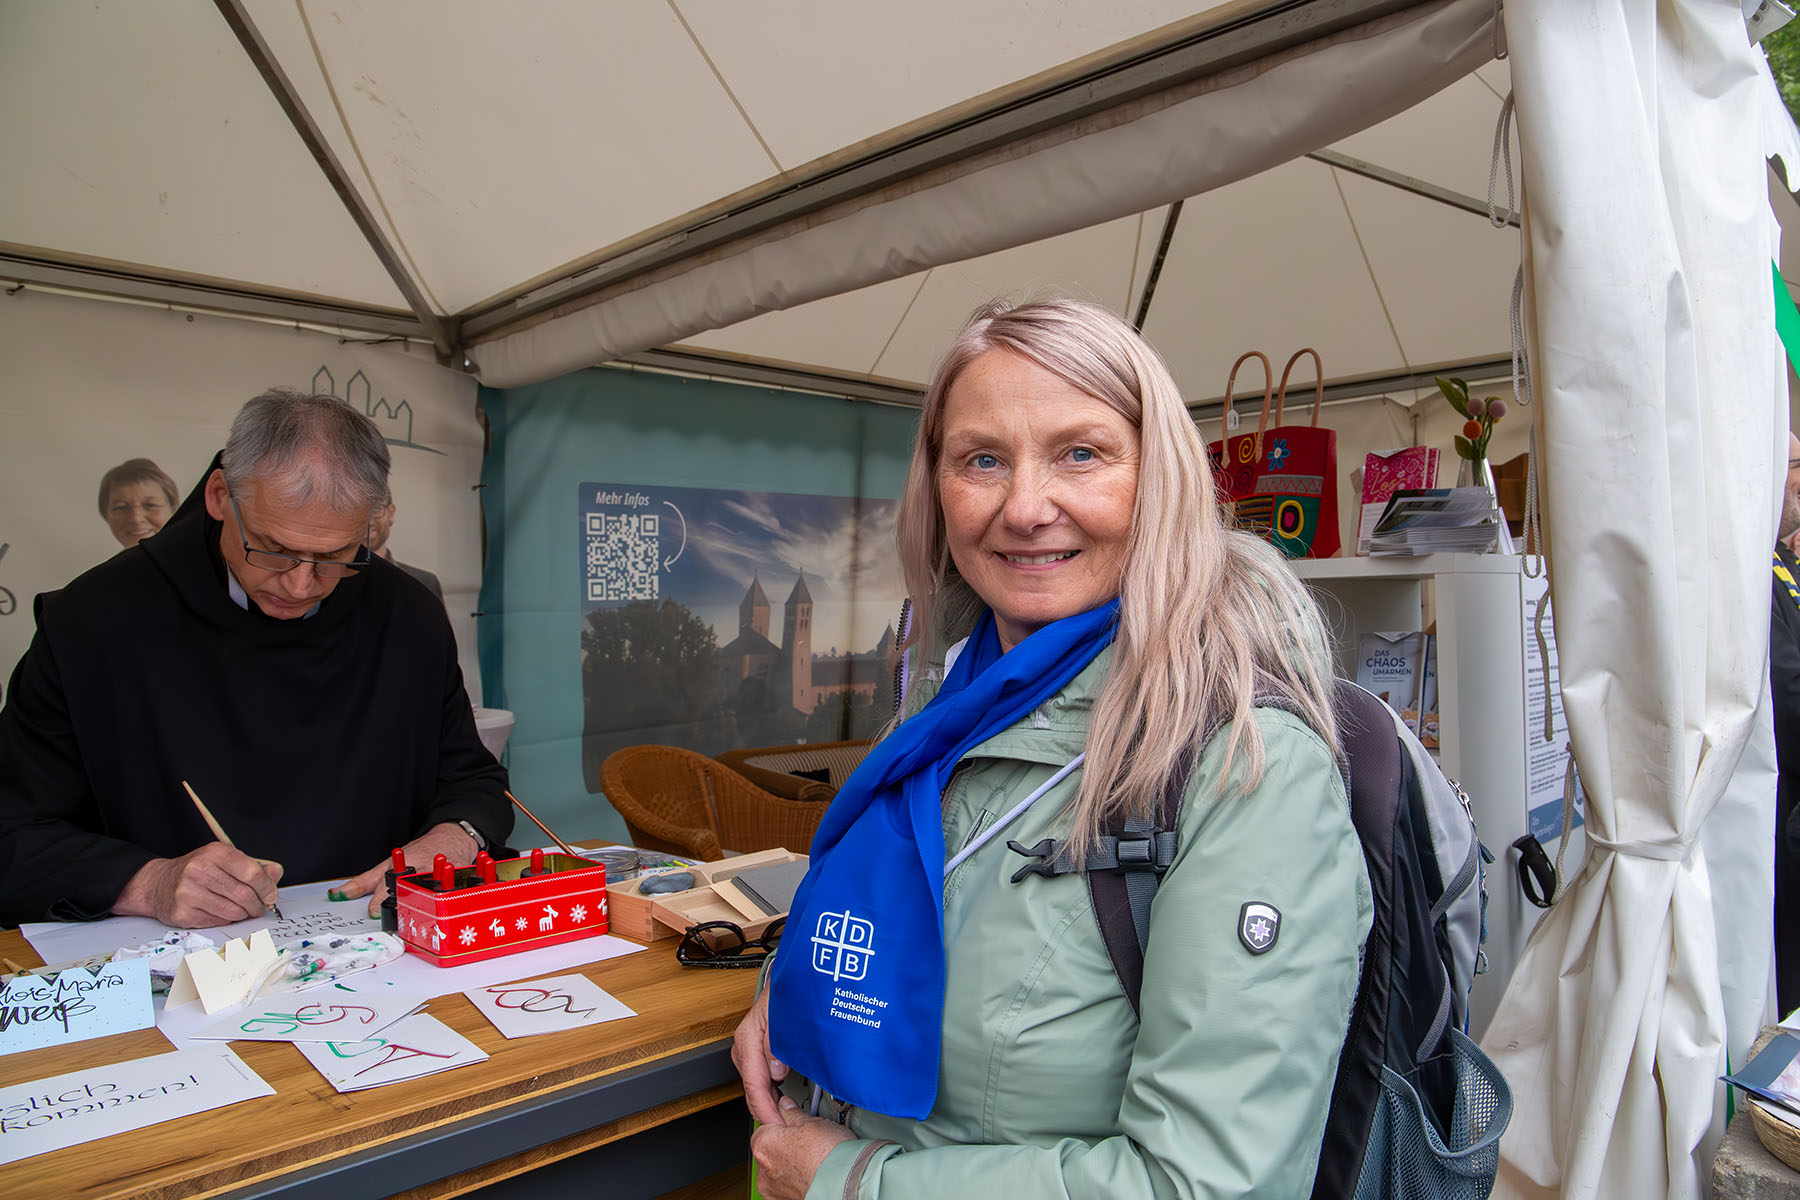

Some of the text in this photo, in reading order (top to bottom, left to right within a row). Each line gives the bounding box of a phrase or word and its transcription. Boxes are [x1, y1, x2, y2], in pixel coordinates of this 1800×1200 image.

[595, 491, 650, 509] Mehr Infos
[1366, 657, 1406, 668] CHAOS
[1373, 668, 1412, 676] UMARMEN
[832, 998, 875, 1016] Deutscher
[834, 987, 889, 1009] Katholischer
[830, 1008, 881, 1029] Frauenbund
